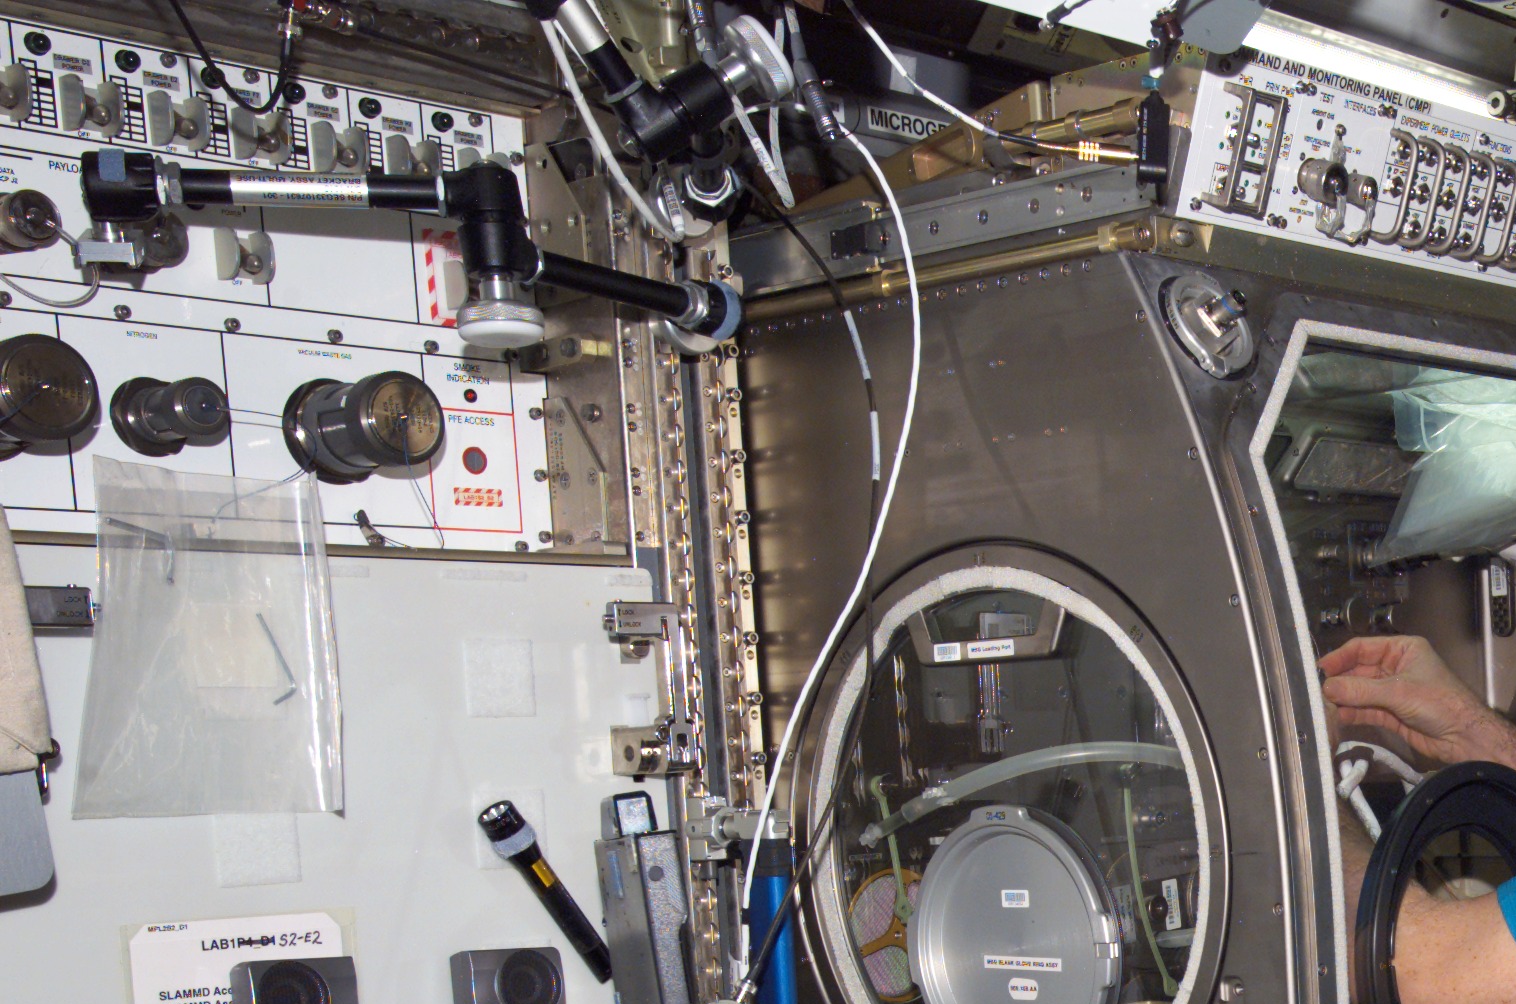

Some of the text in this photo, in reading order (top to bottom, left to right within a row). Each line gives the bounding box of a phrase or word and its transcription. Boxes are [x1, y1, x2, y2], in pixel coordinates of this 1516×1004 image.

[1283, 59, 1432, 115] AND MONITORING PANEL (CMP)
[1320, 91, 1335, 104] TEST
[453, 362, 482, 373] SMOKE
[446, 374, 490, 386] INDICATION
[464, 415, 495, 427] ACCESS
[159, 987, 210, 1001] SLAMMD
